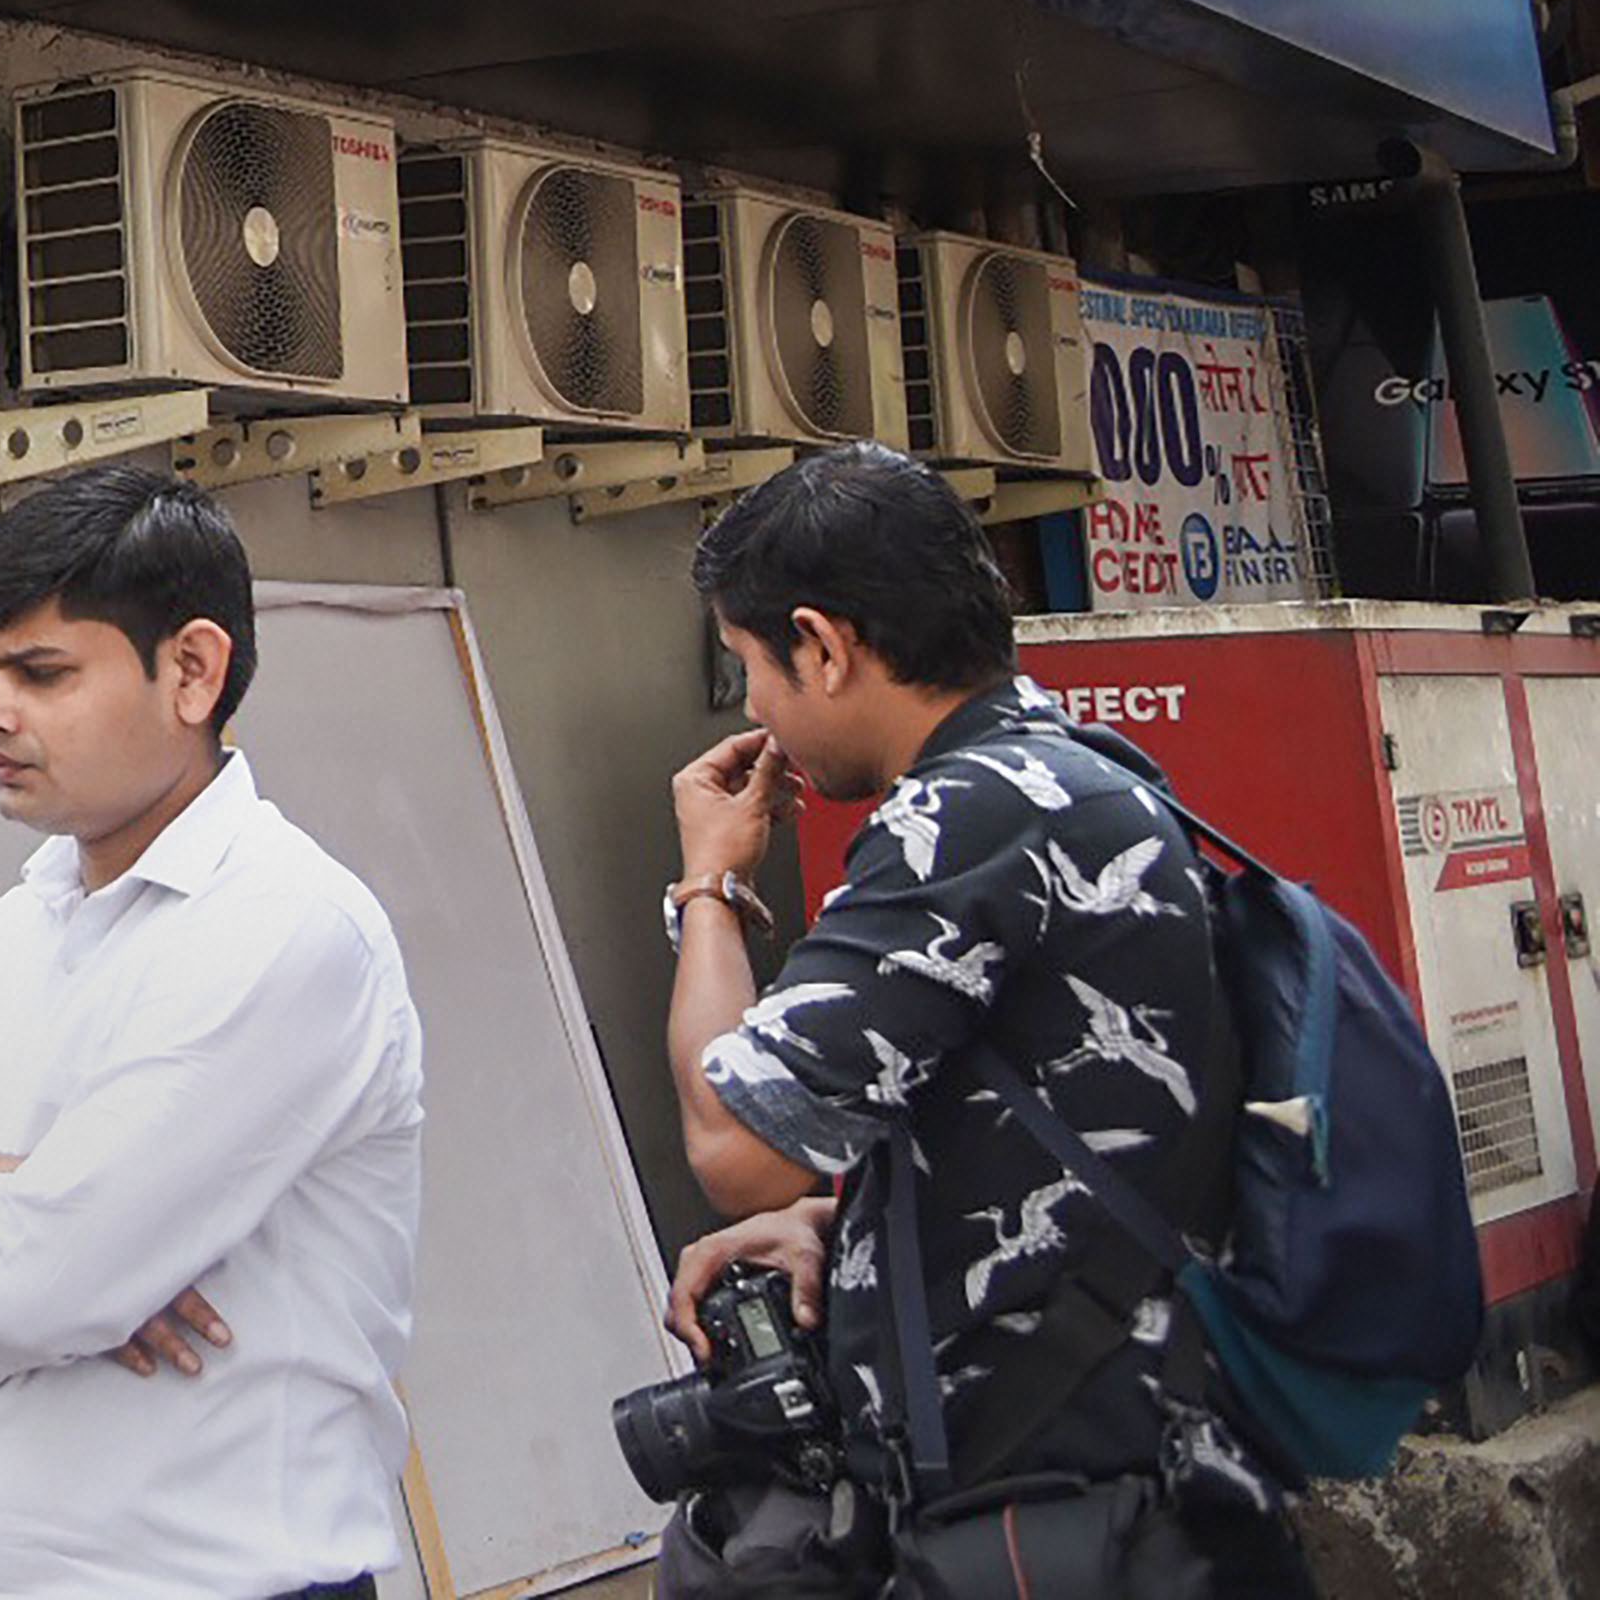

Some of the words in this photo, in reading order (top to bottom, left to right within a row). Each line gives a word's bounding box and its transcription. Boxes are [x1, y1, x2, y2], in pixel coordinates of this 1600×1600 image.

[332, 136, 390, 162] TOSHIBA
[1309, 179, 1394, 206] SAMS
[1374, 369, 1549, 406] Gaxy
